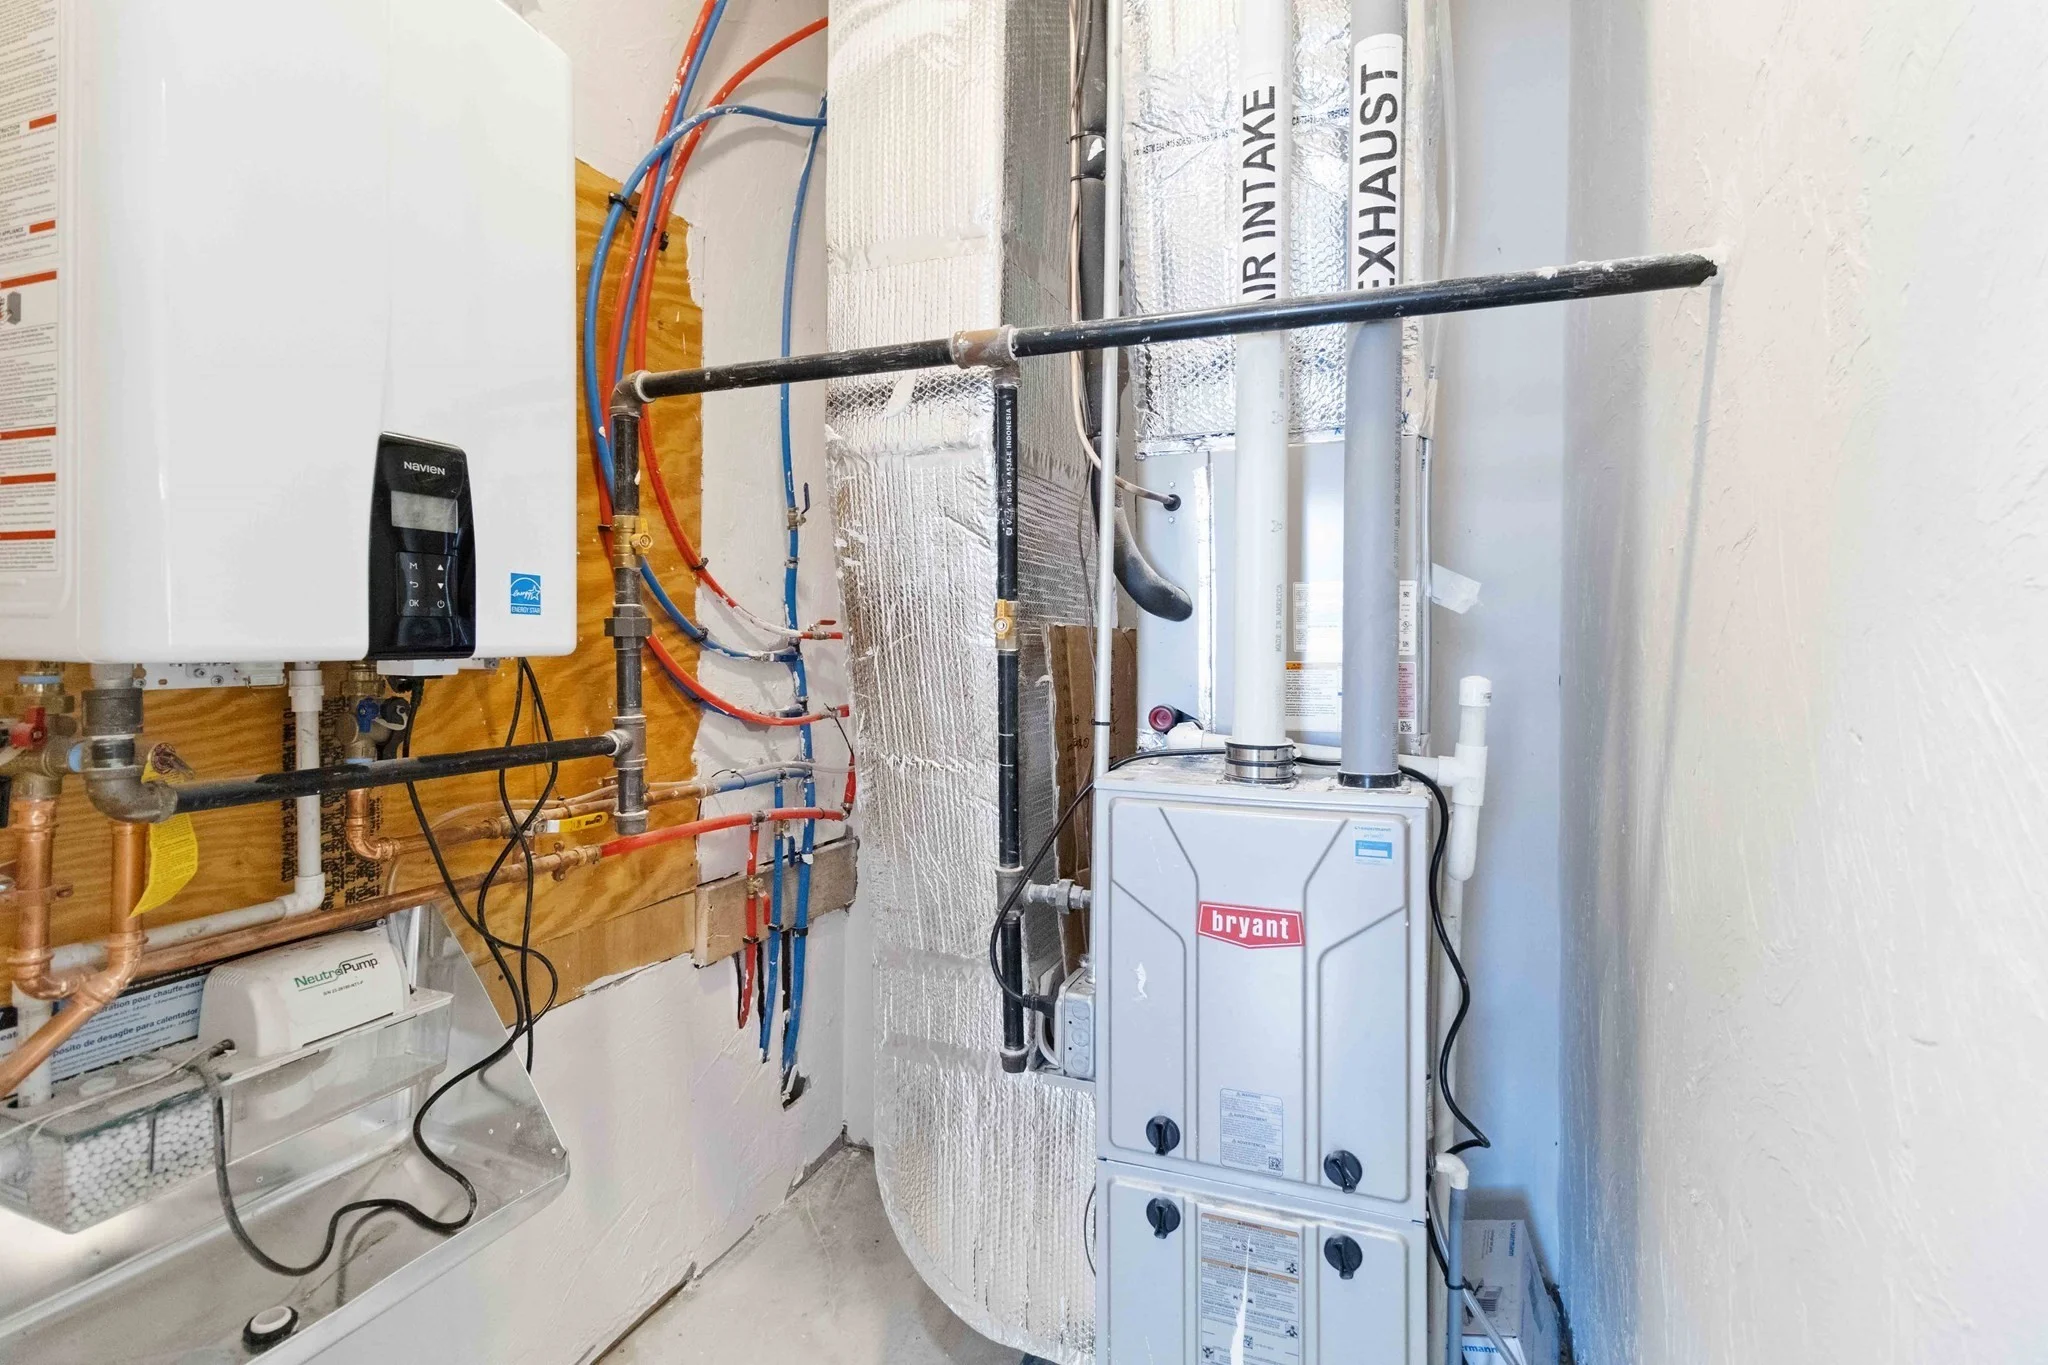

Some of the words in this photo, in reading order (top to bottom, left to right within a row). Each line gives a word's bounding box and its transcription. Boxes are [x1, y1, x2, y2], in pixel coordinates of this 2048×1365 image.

[1243, 85, 1276, 242] INTAKE
[1243, 252, 1276, 300] IR
[1212, 910, 1289, 939] bryant
[132, 994, 151, 1005] pour
[153, 982, 200, 998] chauffe-eau
[84, 1039, 95, 1048] de
[97, 1027, 134, 1043] desagüe
[135, 1021, 155, 1032] para
[156, 1008, 199, 1025] calentador
